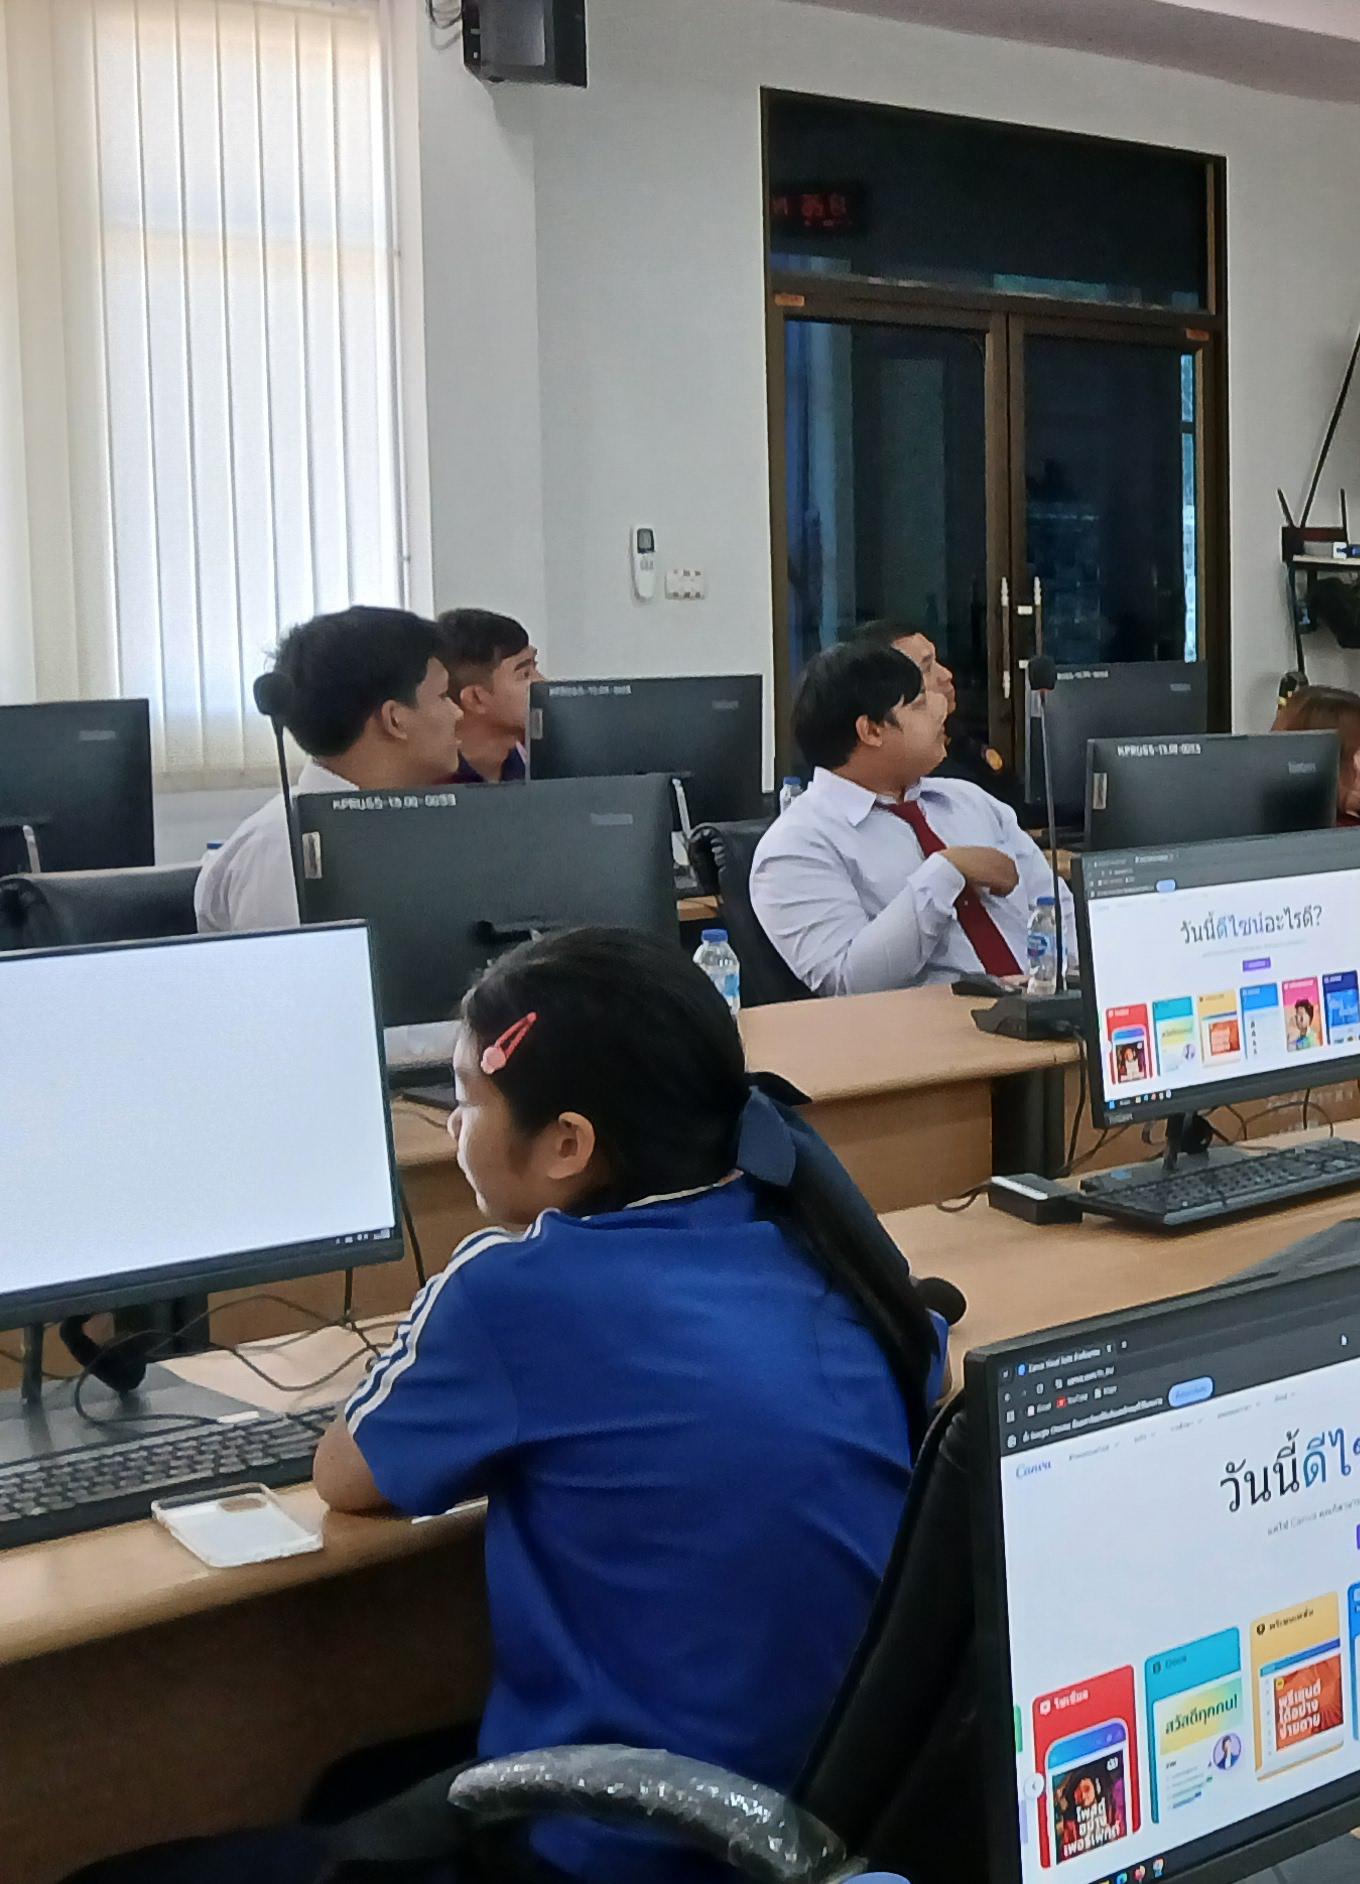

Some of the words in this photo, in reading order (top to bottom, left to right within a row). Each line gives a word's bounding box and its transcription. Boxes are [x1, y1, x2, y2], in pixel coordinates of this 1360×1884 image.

[1180, 904, 1323, 944] วันนี้ดีไซน์อะไรดี?
[1015, 1460, 1052, 1479] Canva
[1164, 1693, 1239, 1736] สวัสดีทุกคน!
